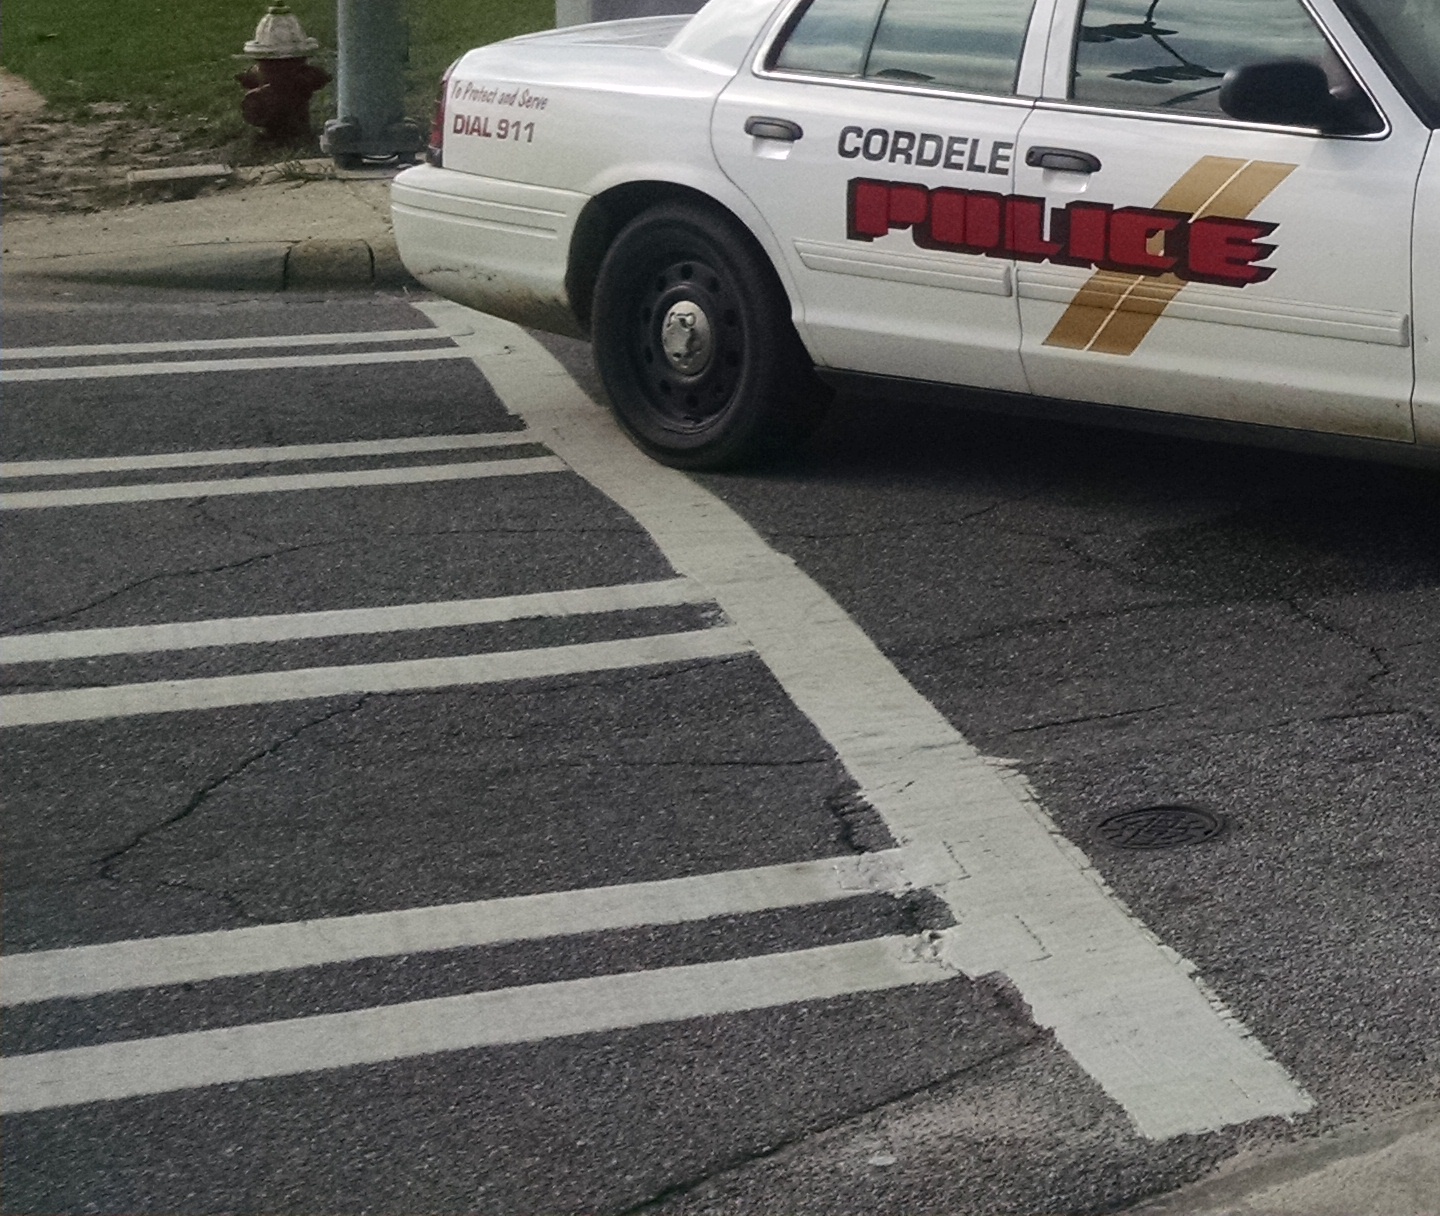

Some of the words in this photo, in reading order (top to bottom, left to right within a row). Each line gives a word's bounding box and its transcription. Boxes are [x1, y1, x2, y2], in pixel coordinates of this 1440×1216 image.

[451, 80, 463, 99] To
[463, 81, 498, 104] Protect
[498, 87, 520, 106] and
[518, 88, 549, 110] Serve
[452, 113, 492, 138] DIAL
[496, 118, 536, 143] 911
[837, 125, 1014, 175] CORDELE
[846, 177, 1281, 288] POLICE
